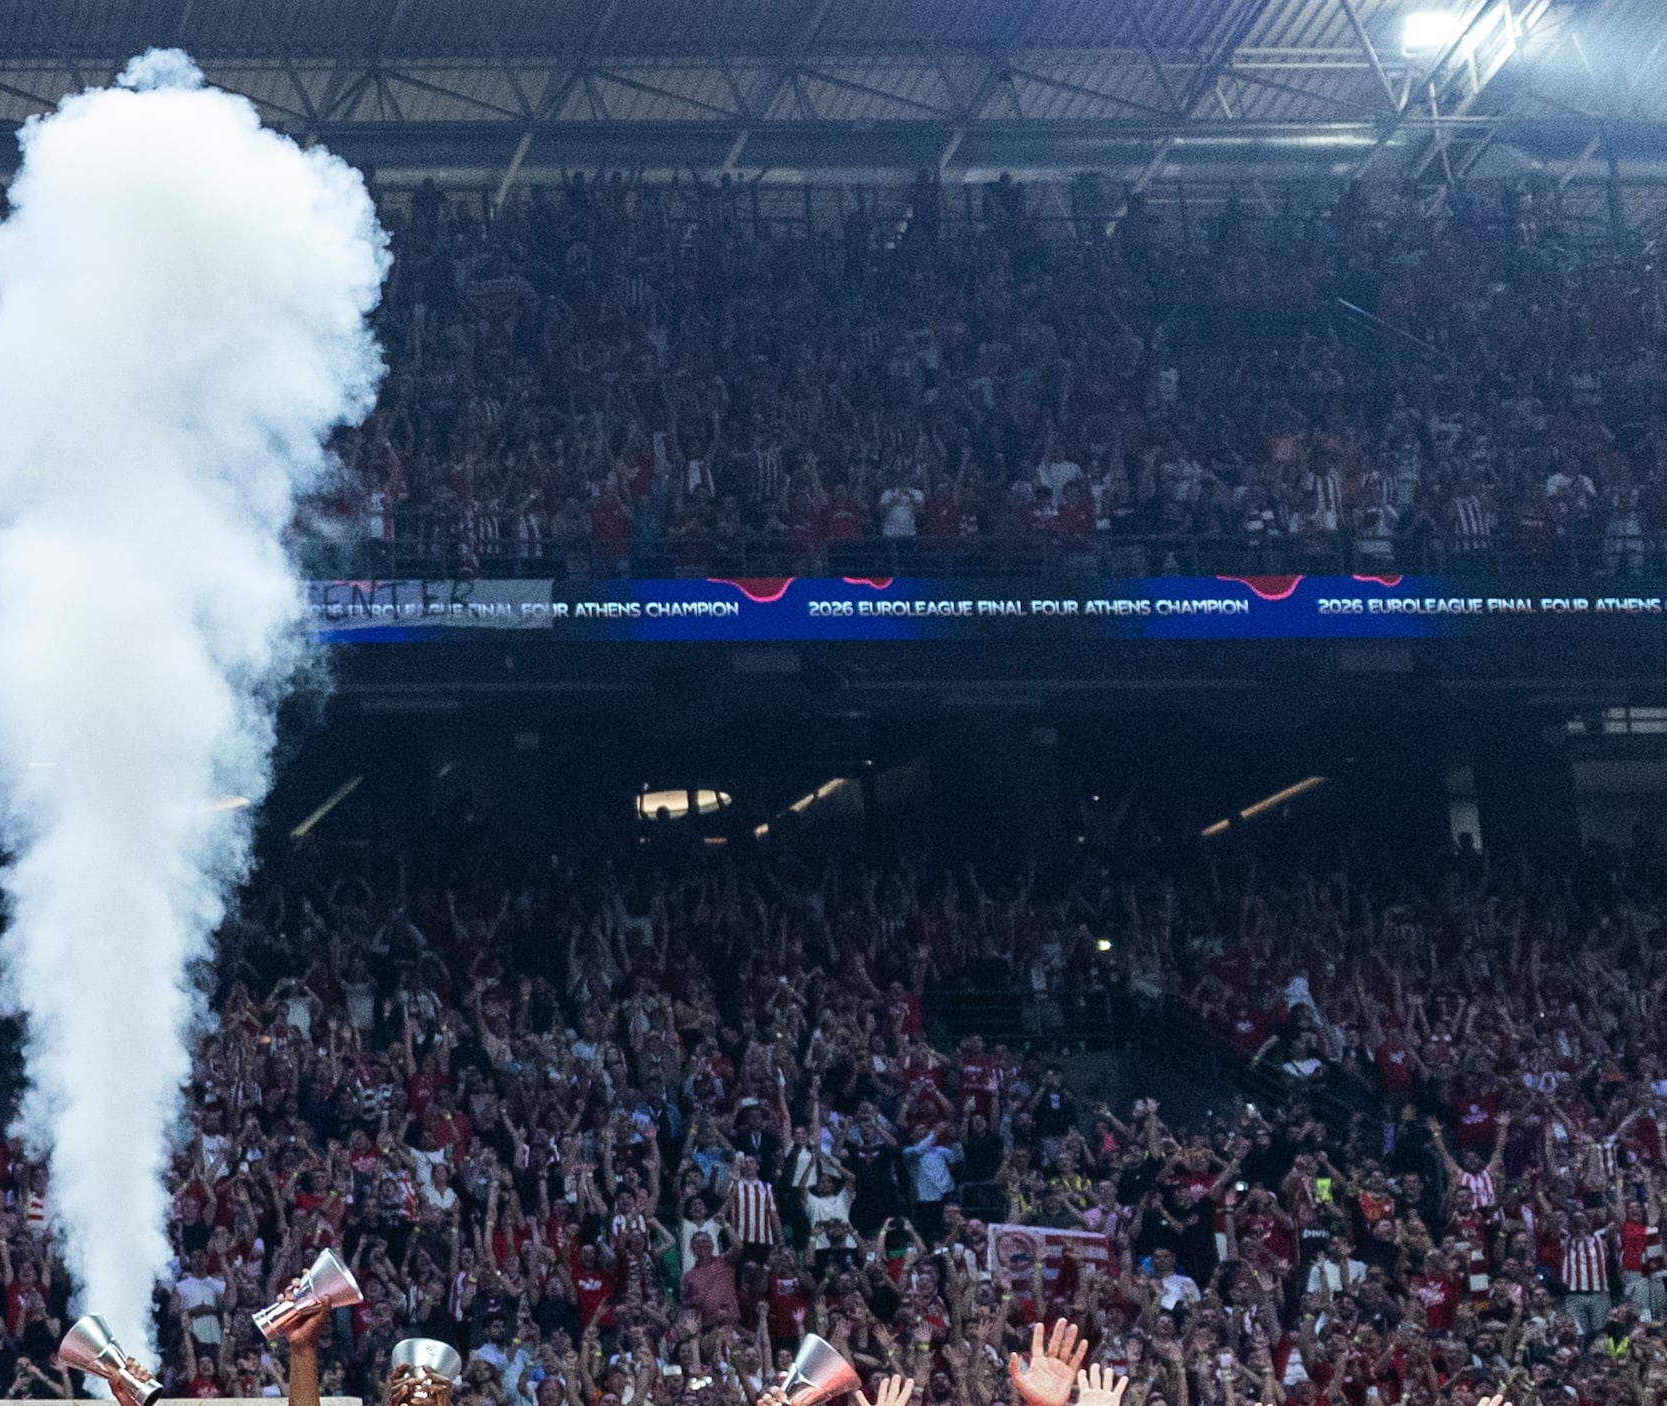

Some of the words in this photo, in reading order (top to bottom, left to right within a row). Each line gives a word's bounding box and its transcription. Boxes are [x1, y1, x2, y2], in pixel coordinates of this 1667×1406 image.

[520, 602, 569, 618] FOUR
[574, 601, 641, 618] ATHENS
[646, 600, 739, 617] CHAMPION
[808, 601, 853, 617] 2026
[858, 600, 973, 617] EUROLEAGUE
[977, 600, 1027, 616] FINAL
[1031, 600, 1079, 616] FOUR
[1084, 599, 1151, 616] ATHENS
[1155, 599, 1249, 615] CHAMPION
[1317, 598, 1363, 615] 2026
[1367, 598, 1484, 614] EUROLEAGUE
[1487, 598, 1537, 614] FINAL
[1540, 598, 1589, 614] FOUR
[1593, 597, 1661, 614] ATHENS
